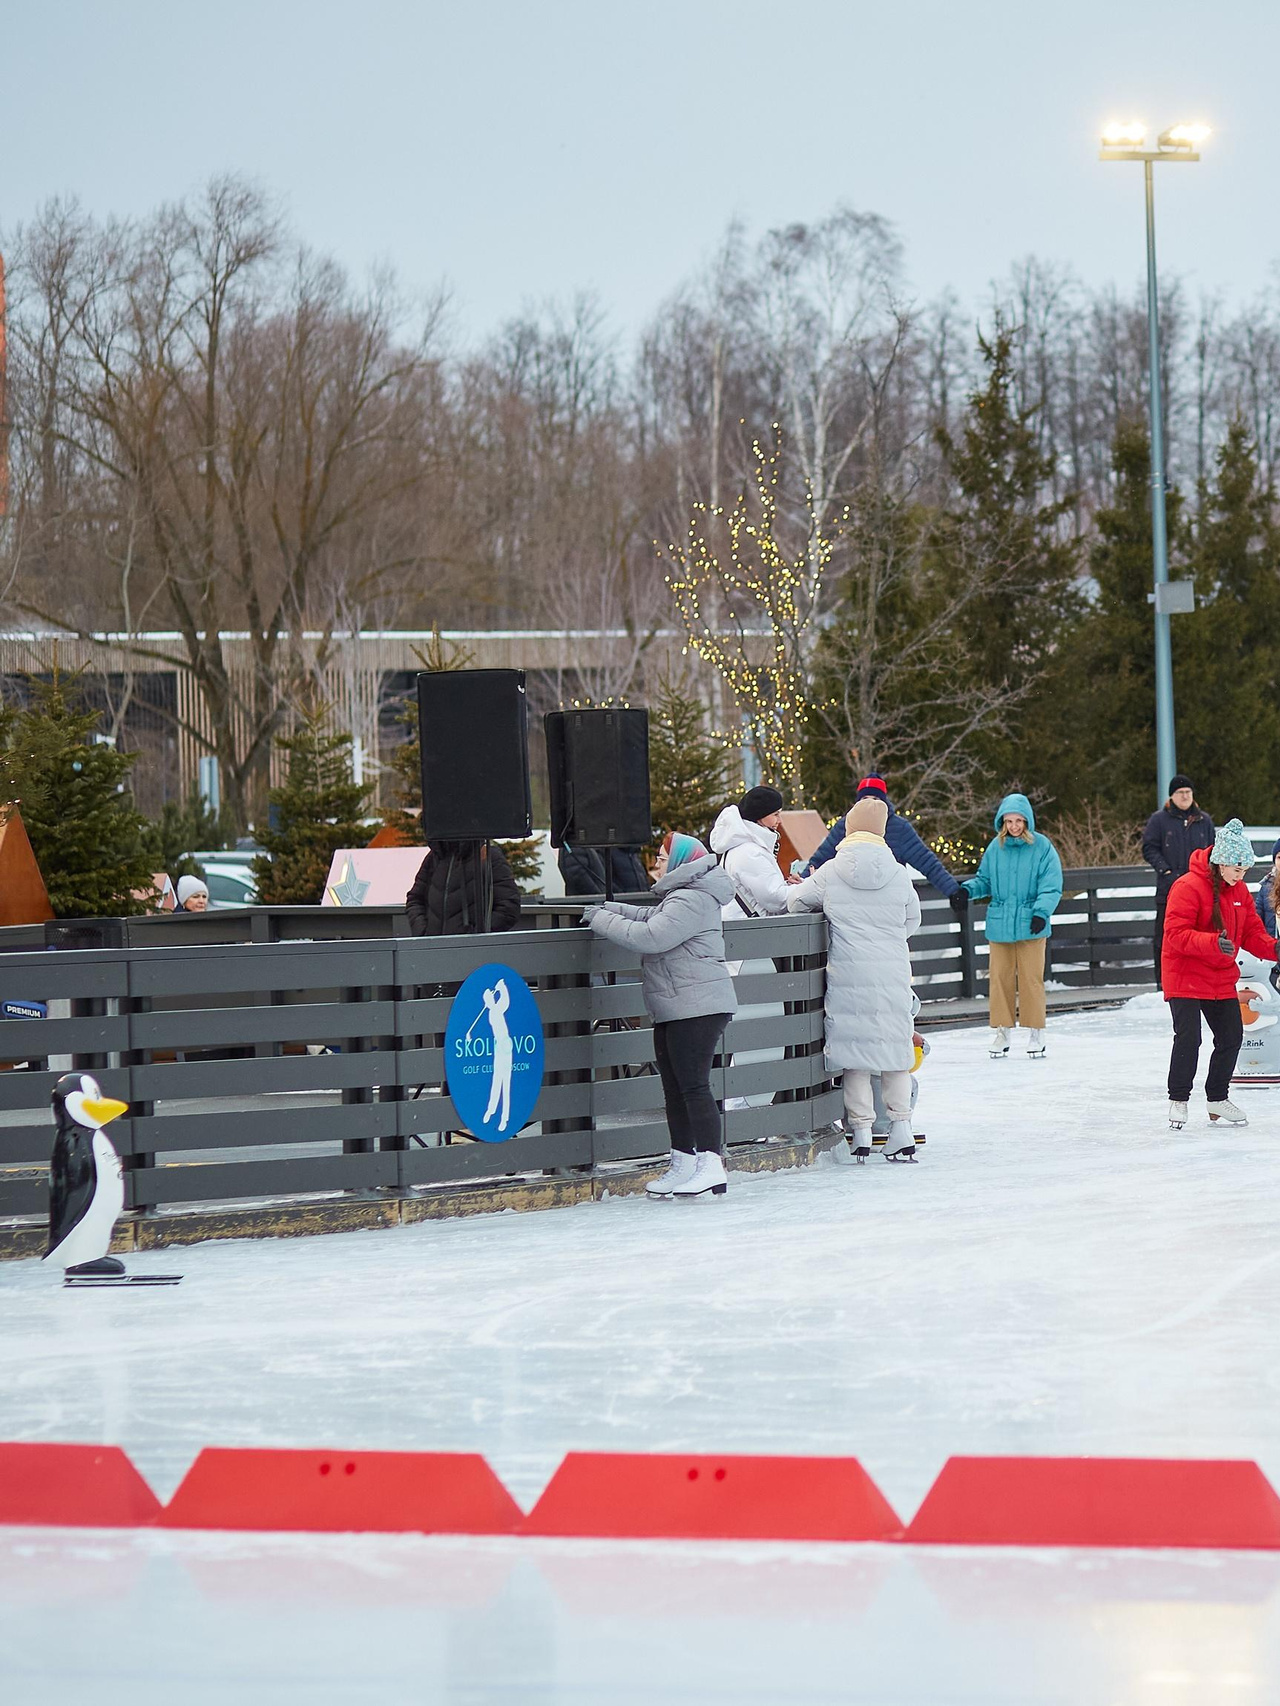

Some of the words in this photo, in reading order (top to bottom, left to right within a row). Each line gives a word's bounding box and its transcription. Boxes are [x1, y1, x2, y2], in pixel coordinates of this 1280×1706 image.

[6, 1005, 41, 1018] PREMIUM
[455, 1034, 537, 1058] SKOLVO
[463, 1065, 480, 1075] GOLF
[481, 1064, 494, 1074] CLU
[510, 1062, 531, 1072] SCOW
